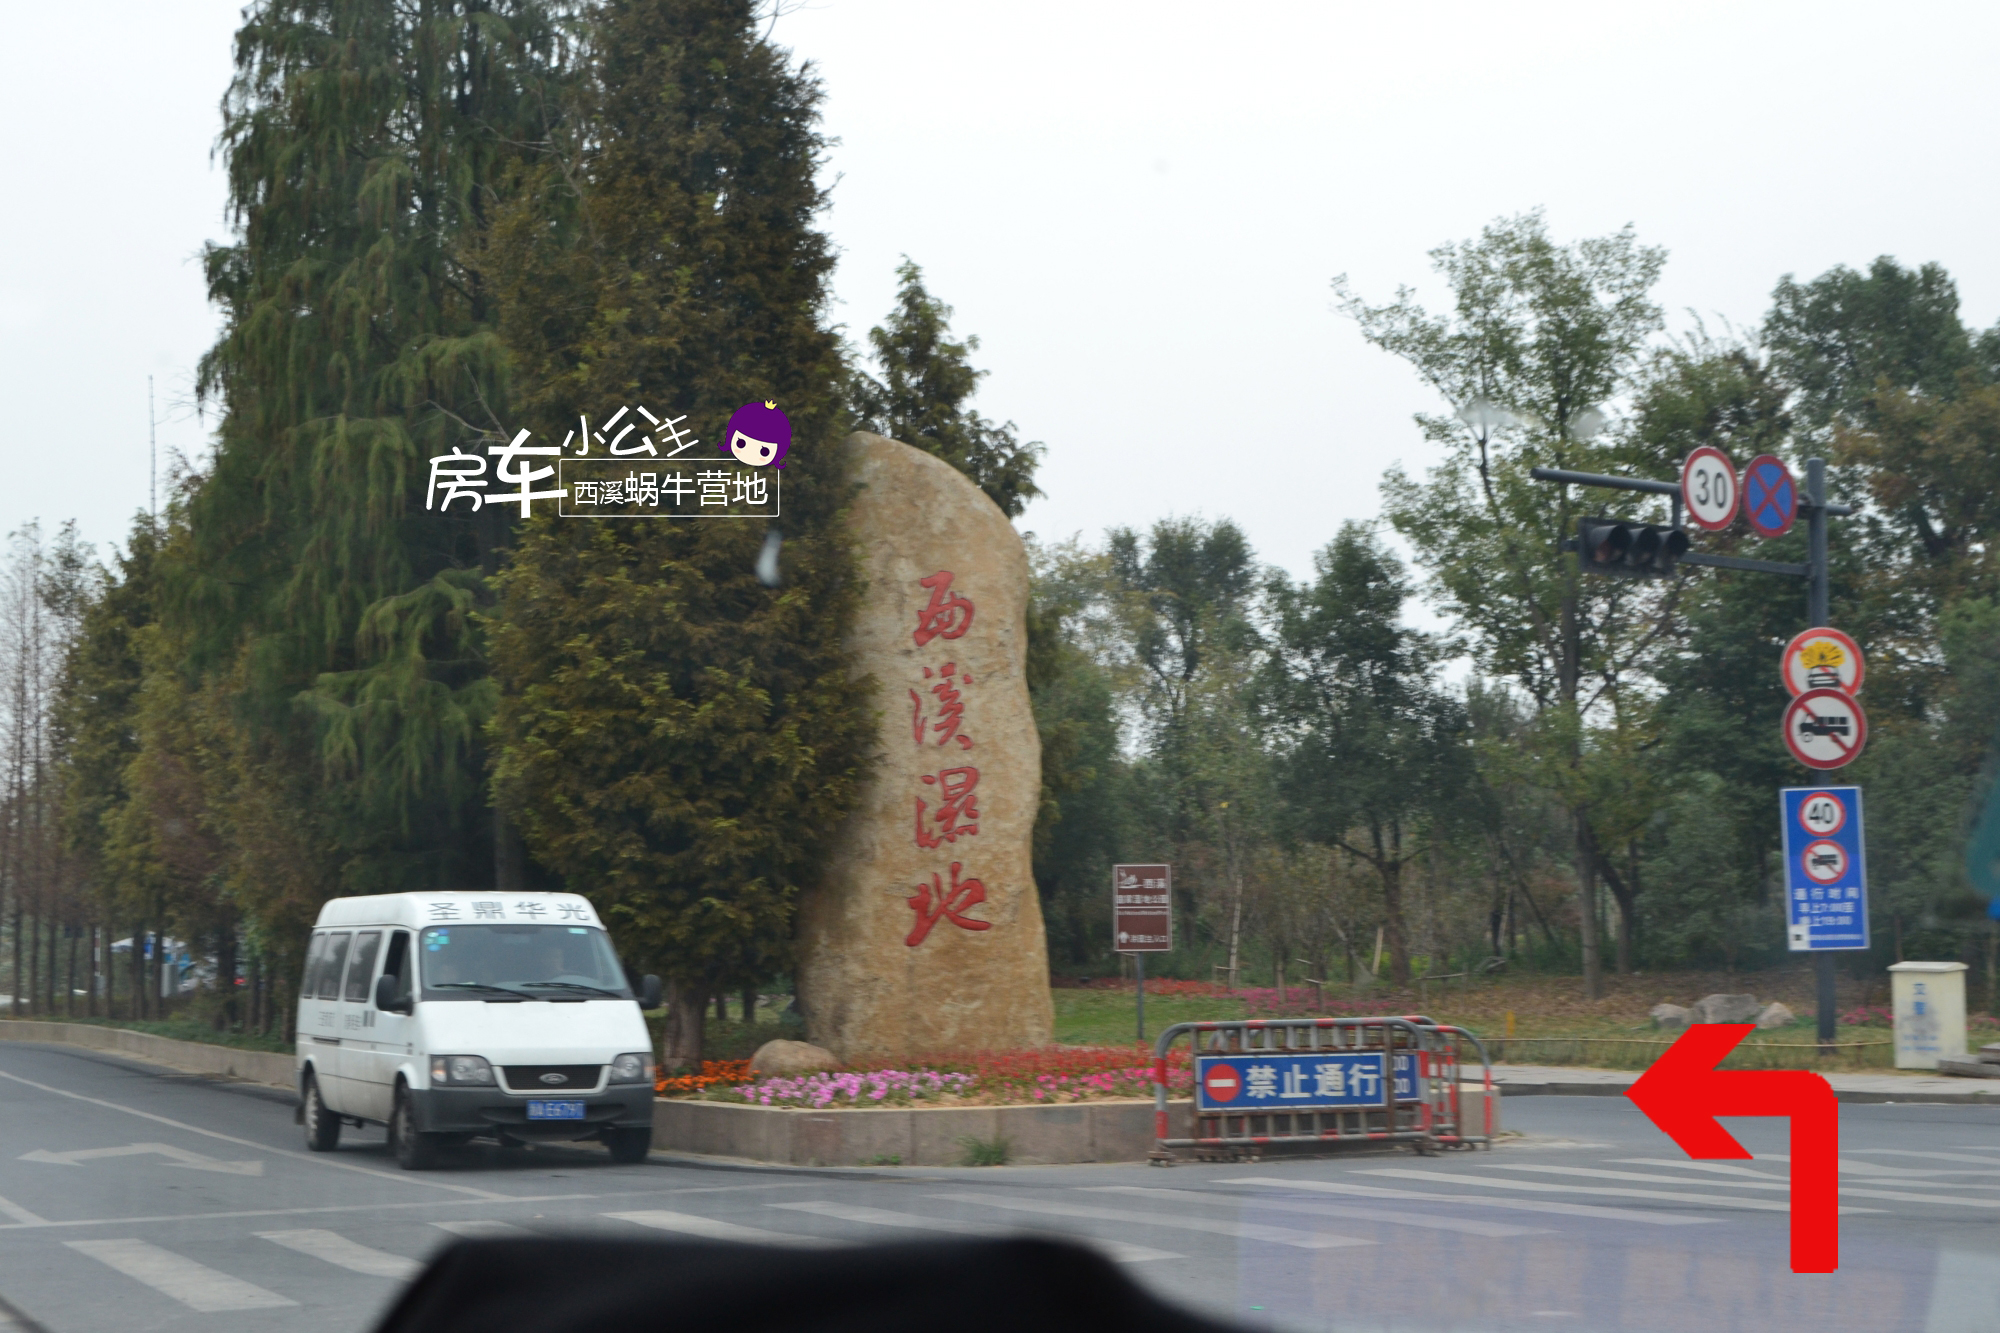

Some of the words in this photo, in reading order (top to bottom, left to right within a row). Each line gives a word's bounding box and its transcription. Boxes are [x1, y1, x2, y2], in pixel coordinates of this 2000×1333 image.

[1696, 469, 1727, 508] 30
[1808, 803, 1835, 824] 40
[427, 901, 591, 921] 圣鼎华光
[1246, 1063, 1379, 1099] 禁止通行
